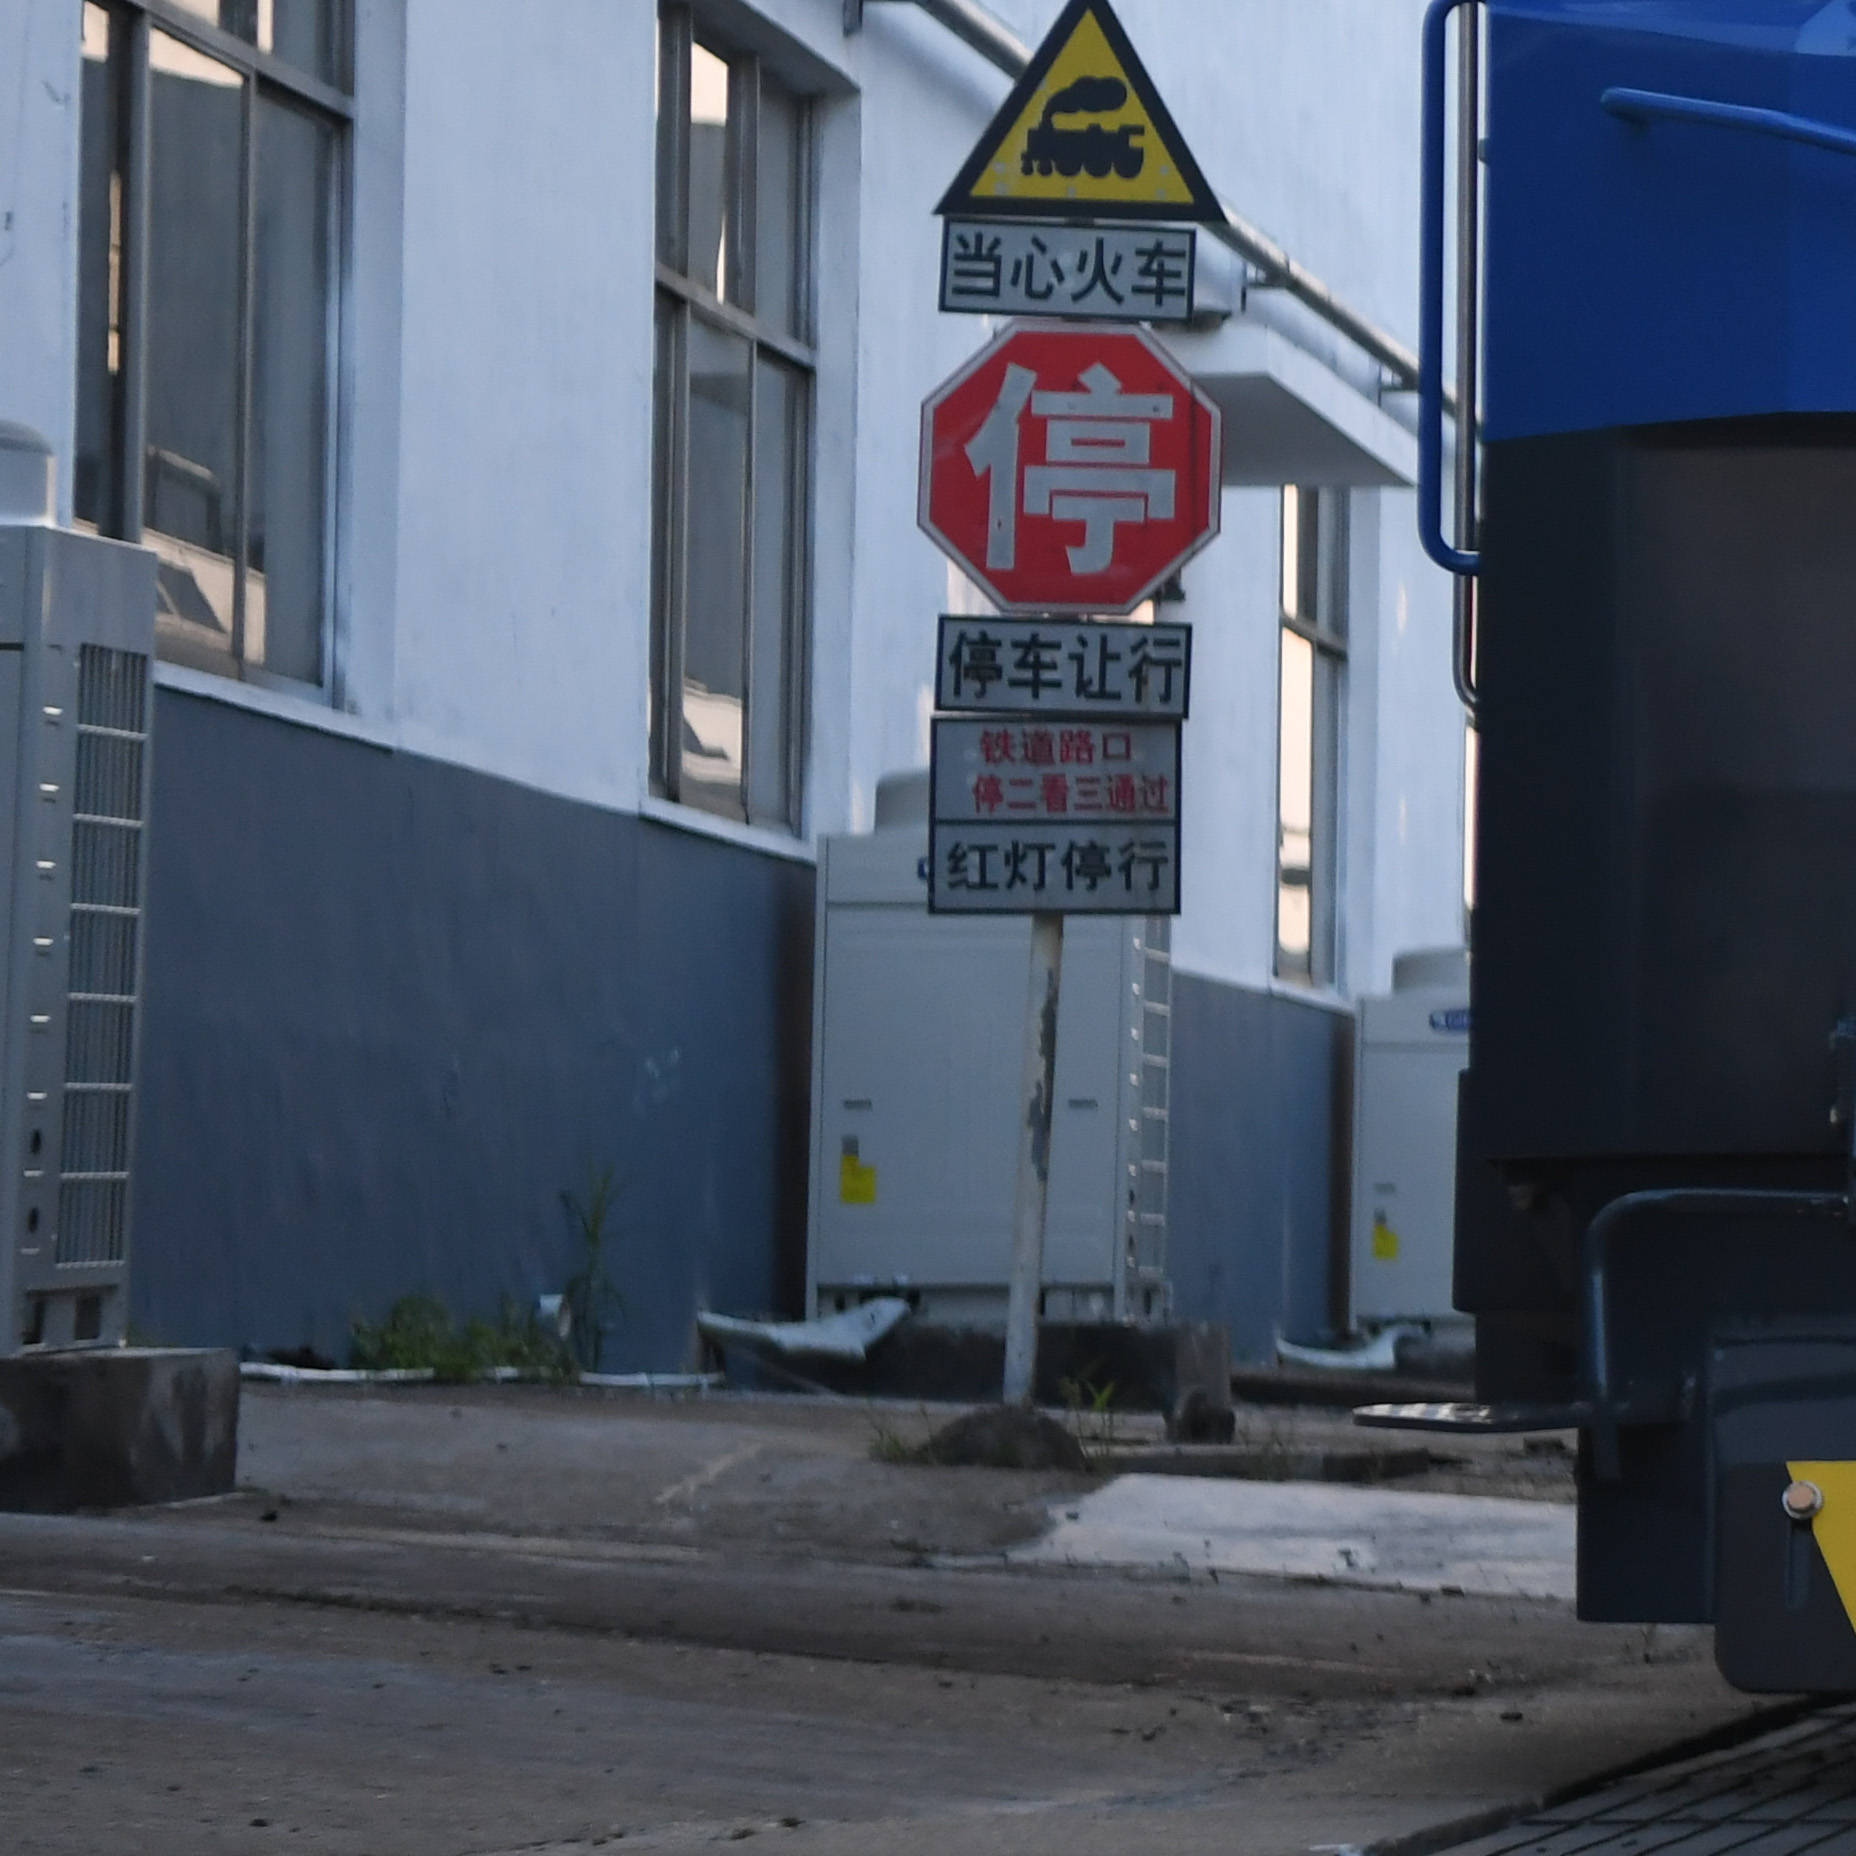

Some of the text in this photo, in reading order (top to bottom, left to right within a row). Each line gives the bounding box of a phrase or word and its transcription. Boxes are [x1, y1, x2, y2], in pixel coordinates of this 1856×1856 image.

[951, 231, 1187, 307] 当心火车
[964, 361, 1176, 575] 停
[949, 629, 1183, 703] 停车让行
[979, 728, 1132, 766] 铁道路口
[947, 839, 1169, 891] 红灯停行
